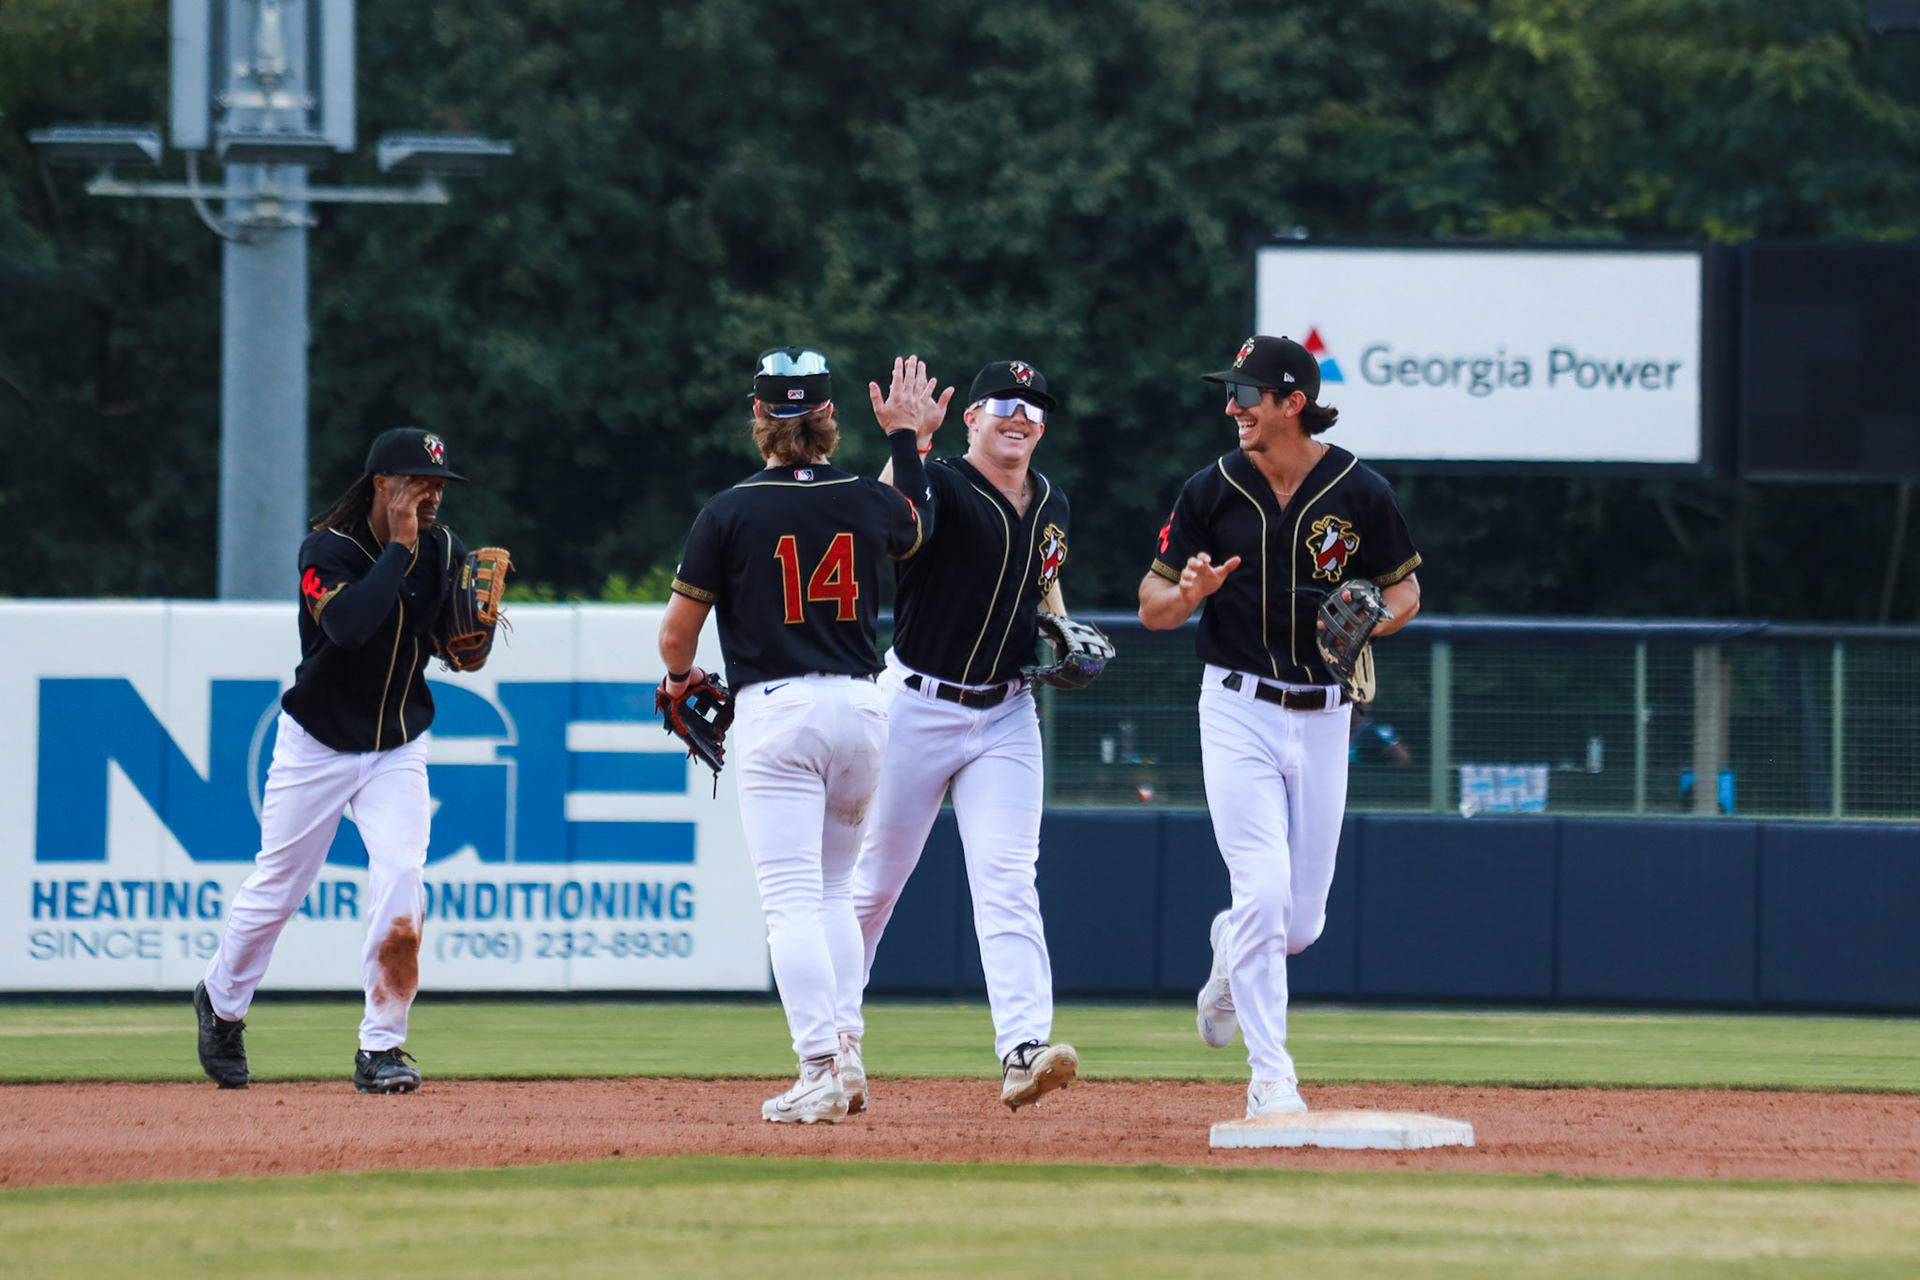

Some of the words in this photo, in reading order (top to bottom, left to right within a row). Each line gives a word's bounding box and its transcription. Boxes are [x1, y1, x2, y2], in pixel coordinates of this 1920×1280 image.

[1360, 345, 1531, 397] Georgia
[1548, 347, 1681, 390] Power
[773, 532, 859, 624] 14
[31, 880, 222, 920] HEATING
[292, 881, 359, 920] AIR
[423, 881, 695, 920] ONDITIONING
[29, 931, 162, 960] SINCE
[175, 931, 220, 960] 19
[435, 931, 523, 964] (706)
